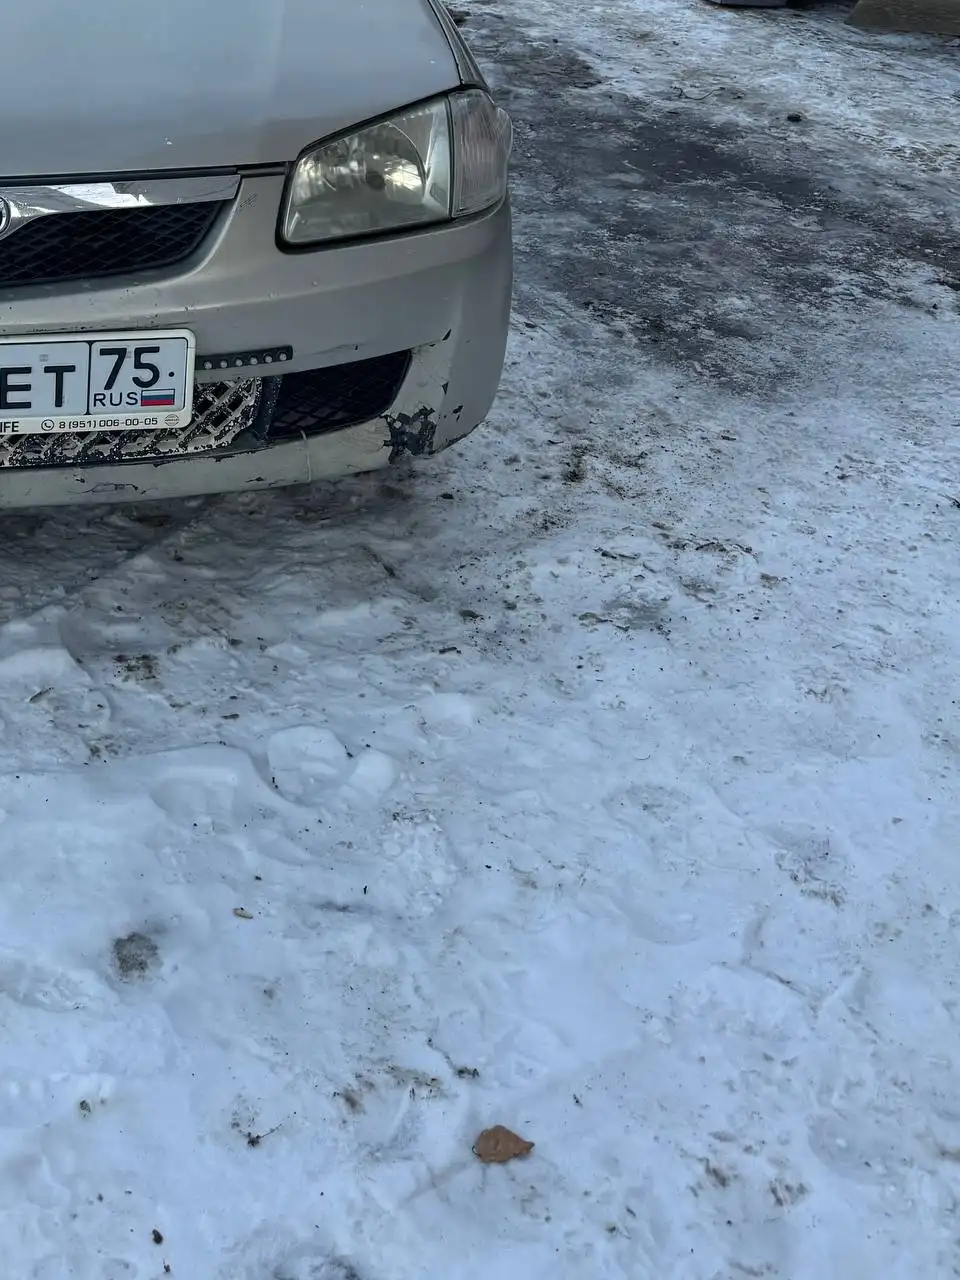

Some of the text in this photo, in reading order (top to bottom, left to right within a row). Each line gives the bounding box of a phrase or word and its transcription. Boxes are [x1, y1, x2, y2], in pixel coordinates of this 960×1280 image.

[98, 345, 161, 392] 75
[93, 391, 138, 408] RUS
[58, 422, 66, 430] 8
[68, 420, 97, 430] (951)
[98, 417, 159, 428] 006-00-05
